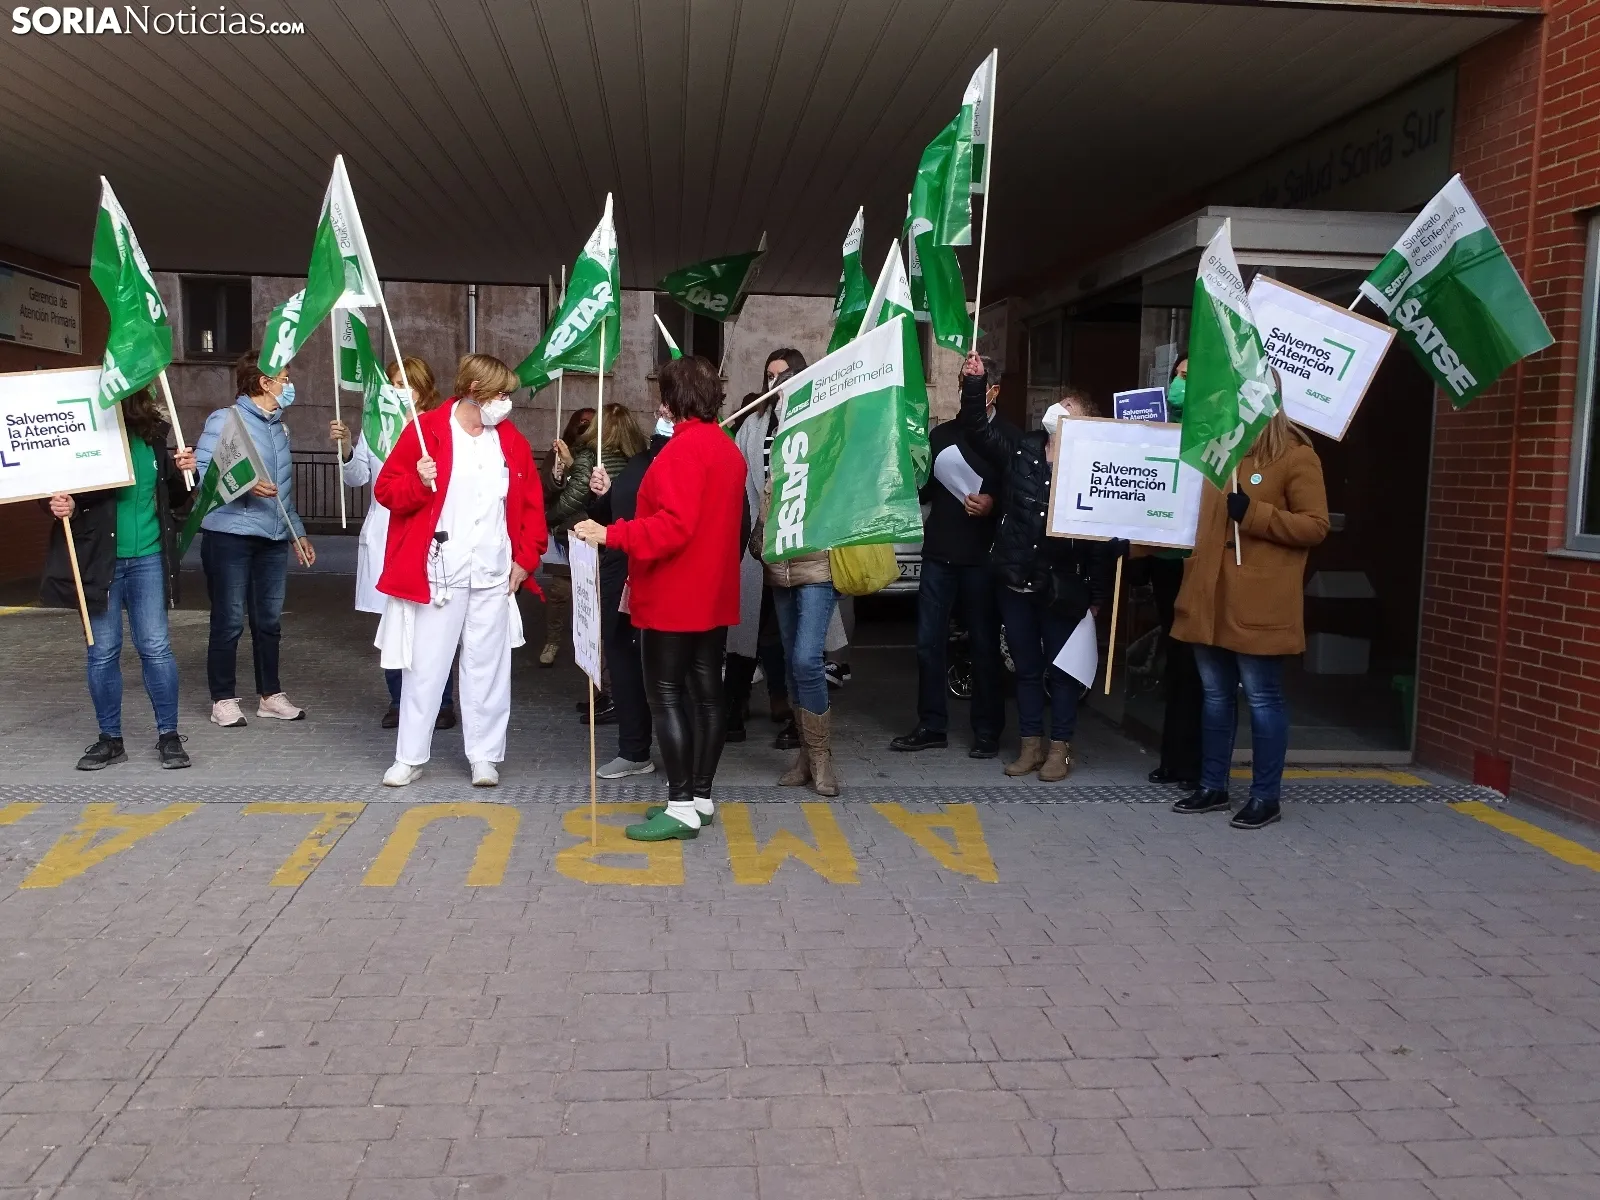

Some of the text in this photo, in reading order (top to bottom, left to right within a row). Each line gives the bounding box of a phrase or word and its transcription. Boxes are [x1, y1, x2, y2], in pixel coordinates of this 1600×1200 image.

[1285, 147, 1334, 207] Salud
[1338, 127, 1394, 184] Soria
[1401, 107, 1446, 158] Sur
[1402, 212, 1441, 250] Sindicato
[1410, 244, 1421, 258] de
[1414, 243, 1443, 267] Castilla
[1384, 267, 1412, 297] SATSE
[29, 287, 68, 309] Gerencia de
[19, 303, 77, 329] Atención Primaria
[1269, 327, 1332, 361] Salvemos
[1395, 298, 1478, 397] SATSE
[1264, 337, 1334, 376] la Atención
[814, 360, 864, 391] Sindicato
[812, 391, 827, 404] de
[1305, 388, 1332, 403] SATSE
[6, 409, 75, 427] Salvemos
[1122, 408, 1153, 416] Salvemos
[8, 420, 87, 439] la Atención
[11, 435, 70, 452] Primaria
[75, 450, 102, 459] SATSE
[1092, 461, 1158, 478] Salvemos
[1090, 473, 1166, 491] la Atención
[776, 431, 810, 556] SATSE
[1089, 486, 1146, 502] Primaria
[1147, 509, 1174, 519] SATSE
[0, 801, 999, 890] AMBULA
